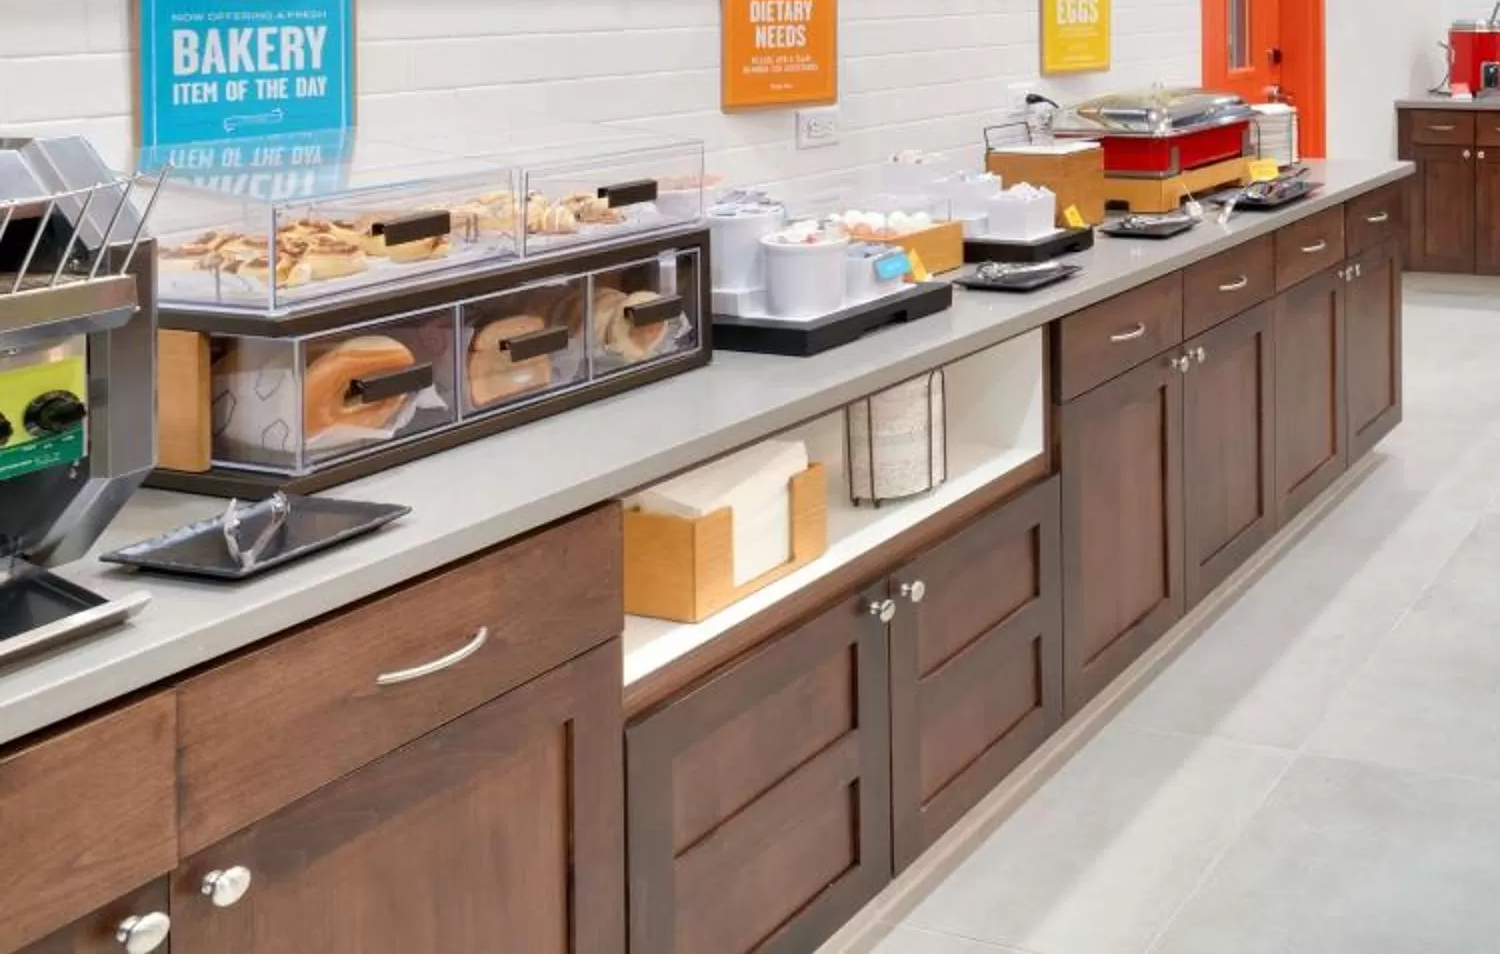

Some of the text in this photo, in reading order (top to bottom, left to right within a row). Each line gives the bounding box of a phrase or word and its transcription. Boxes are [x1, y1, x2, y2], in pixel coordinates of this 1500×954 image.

[749, 0, 813, 23] DIETARY
[756, 24, 807, 49] NEEDS
[172, 25, 328, 76] BAKERY
[172, 76, 328, 106] ITEM OF THE DAY
